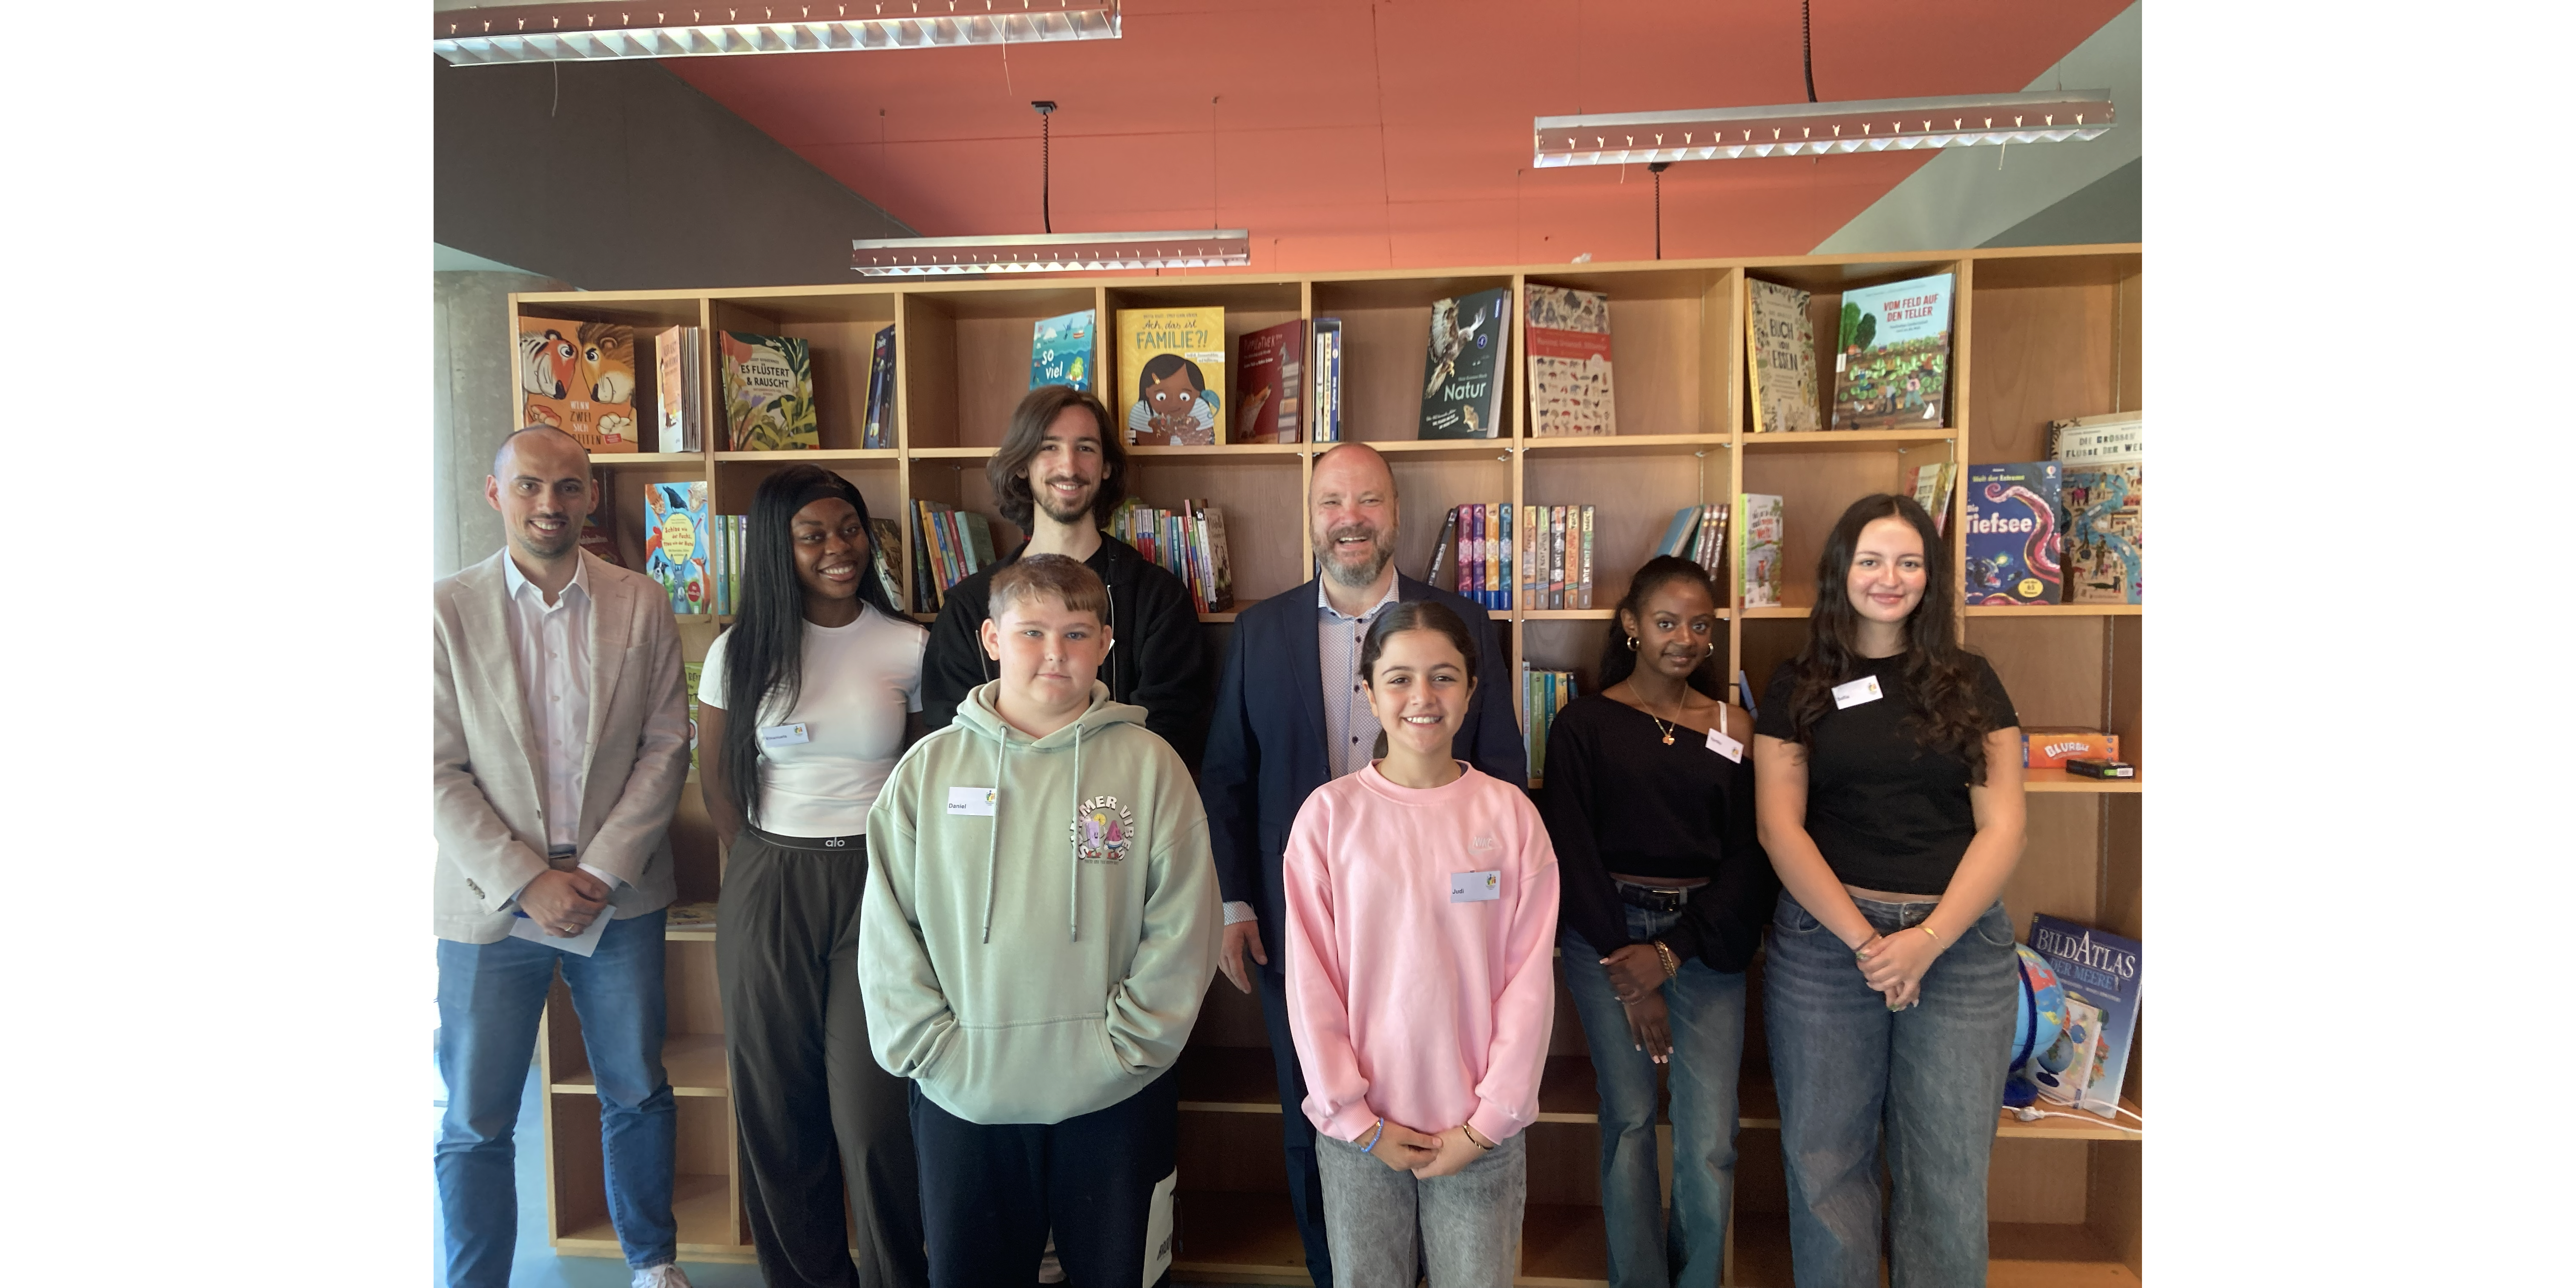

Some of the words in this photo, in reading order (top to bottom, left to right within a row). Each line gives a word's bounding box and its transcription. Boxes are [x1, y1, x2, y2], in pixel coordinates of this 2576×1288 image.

[1884, 300, 1900, 311] VOM
[1903, 296, 1921, 308] FELD
[1923, 293, 1939, 305] AUF
[1887, 311, 1902, 322] DEN
[1905, 306, 1933, 319] TELLER
[1165, 320, 1180, 330] das
[1184, 319, 1197, 328] ist
[1770, 318, 1794, 340] BUCH
[1773, 350, 1798, 371] ESSEN
[741, 365, 750, 374] ES
[752, 364, 790, 377] FLÜSTERT
[1046, 361, 1063, 380] viel
[747, 377, 752, 385] &
[754, 378, 789, 388] RAUSCHT
[1444, 381, 1486, 402] Natur
[570, 411, 591, 422] ZWEI
[573, 423, 589, 432] SICH
[1966, 512, 2033, 534] Tiefsee
[1117, 805, 1134, 860] VIBES
[825, 837, 845, 847] alo
[1473, 837, 1492, 848] NIKE
[2050, 958, 2072, 976] DER
[2075, 966, 2115, 990] MEERE
